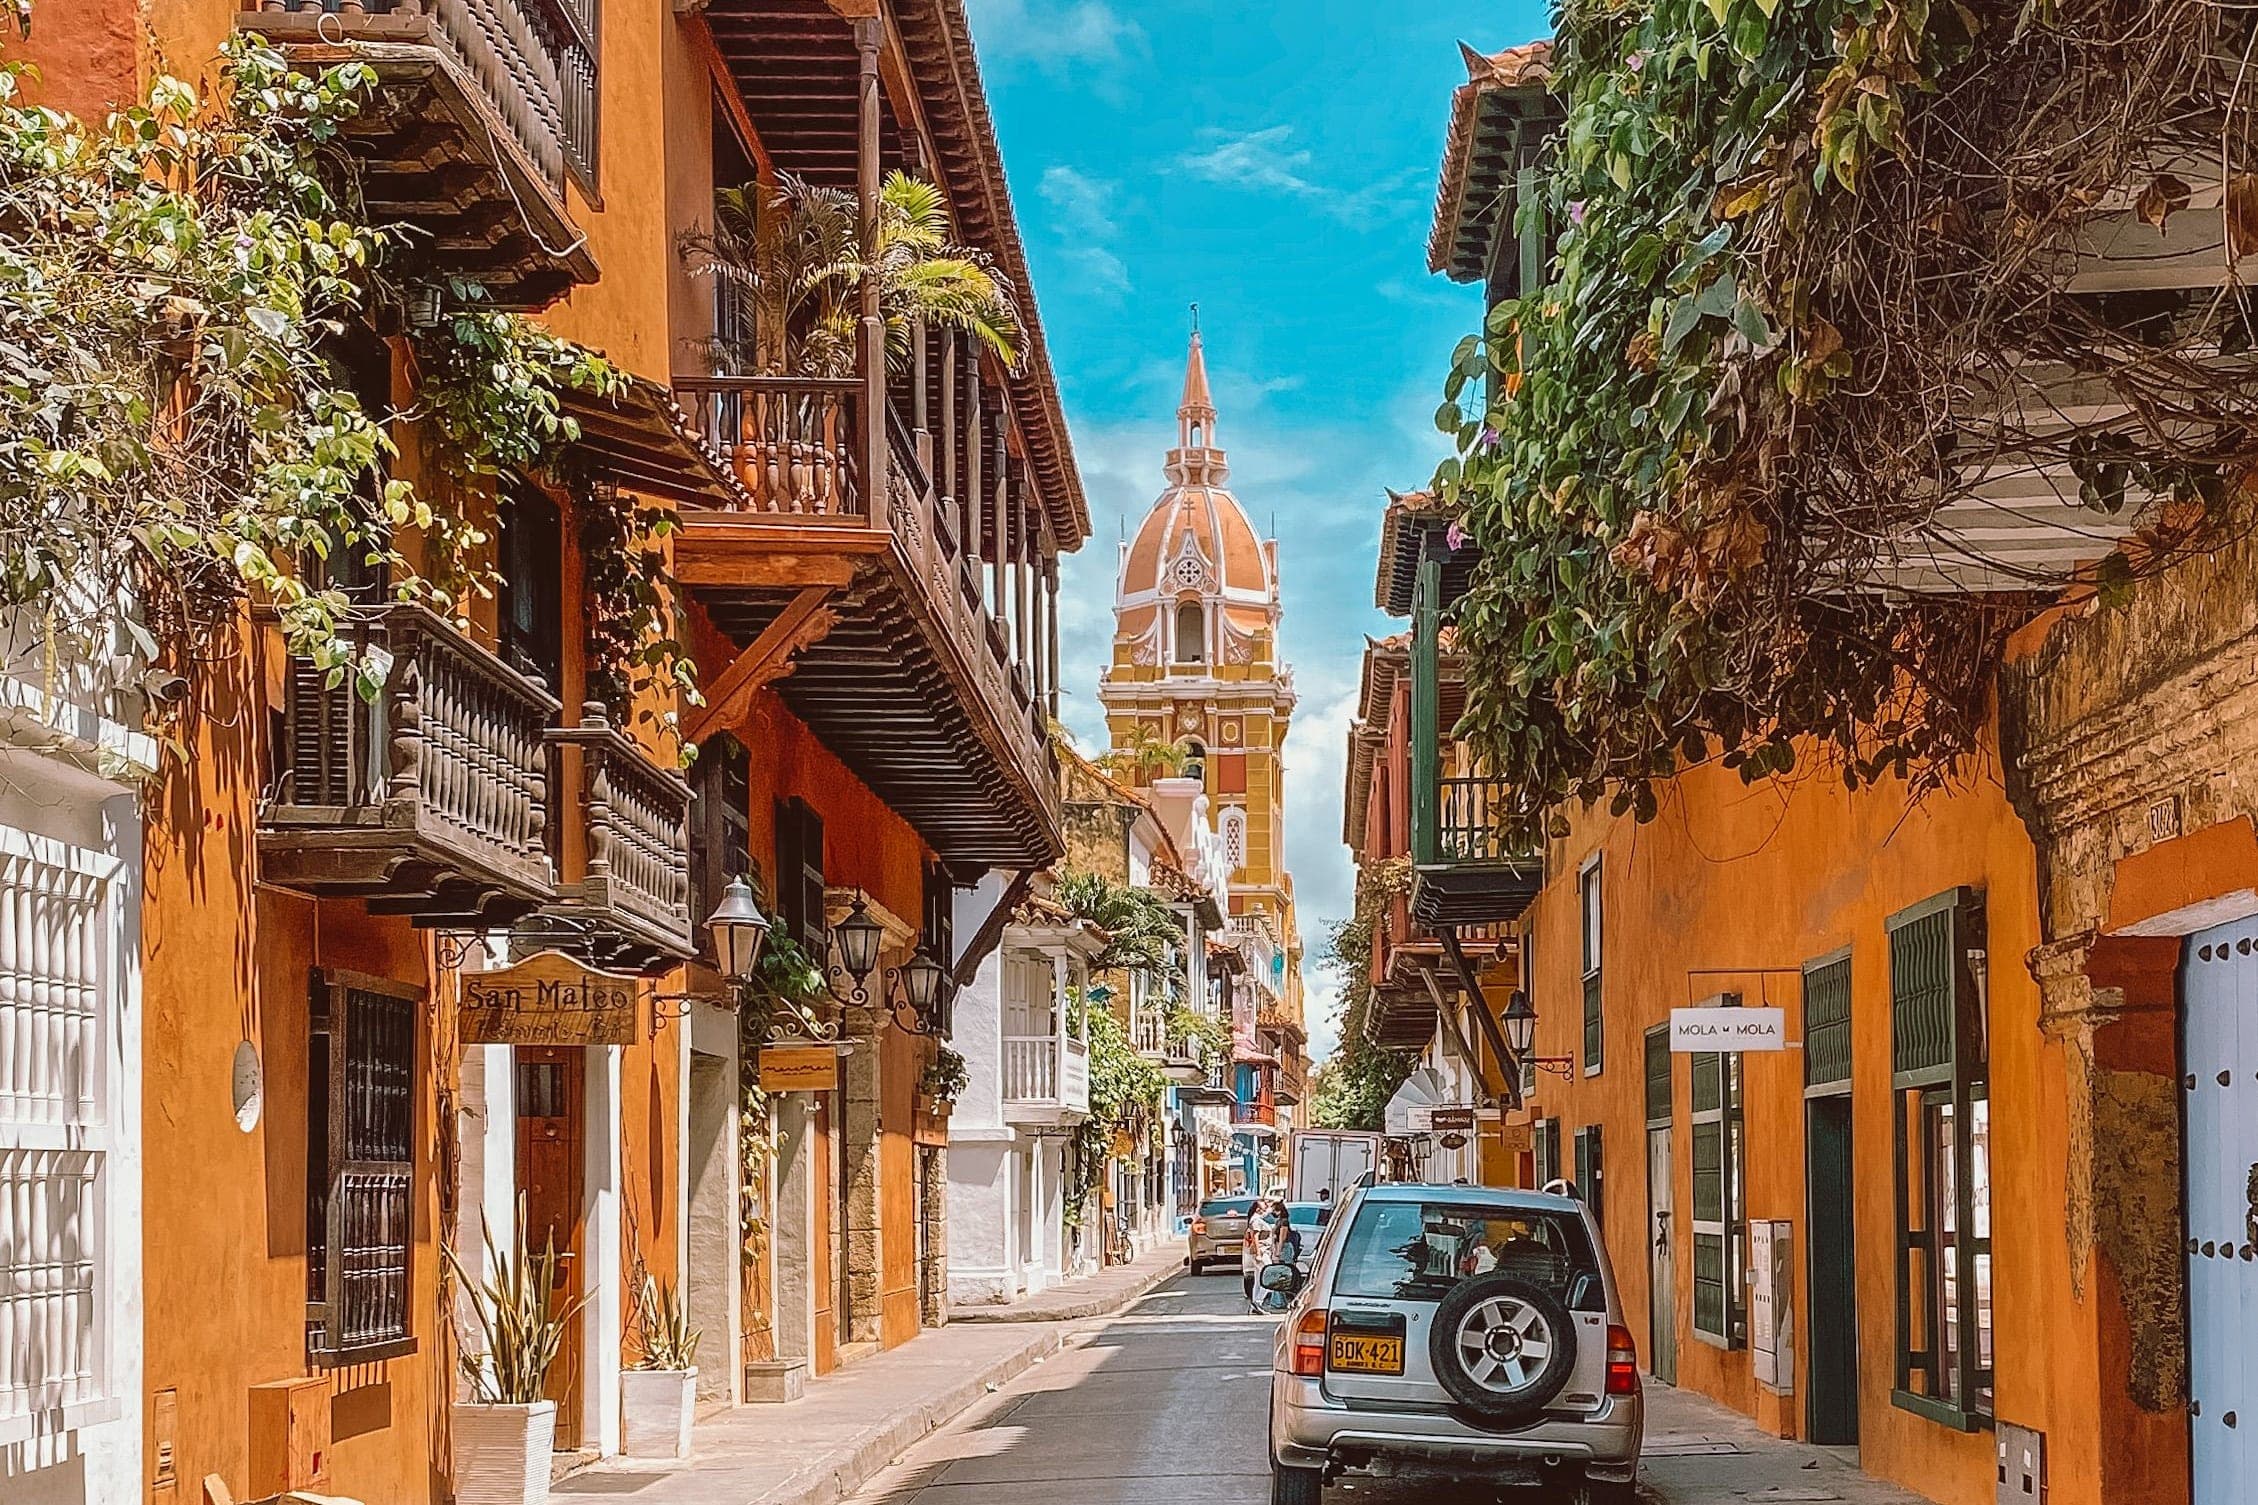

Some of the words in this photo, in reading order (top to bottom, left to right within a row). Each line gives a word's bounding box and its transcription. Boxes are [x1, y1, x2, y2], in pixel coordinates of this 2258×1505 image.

[467, 979, 522, 1013] San
[536, 975, 628, 1013] Mateo
[1679, 1024, 1718, 1036] MOLA
[1736, 1023, 1776, 1036] MOLA
